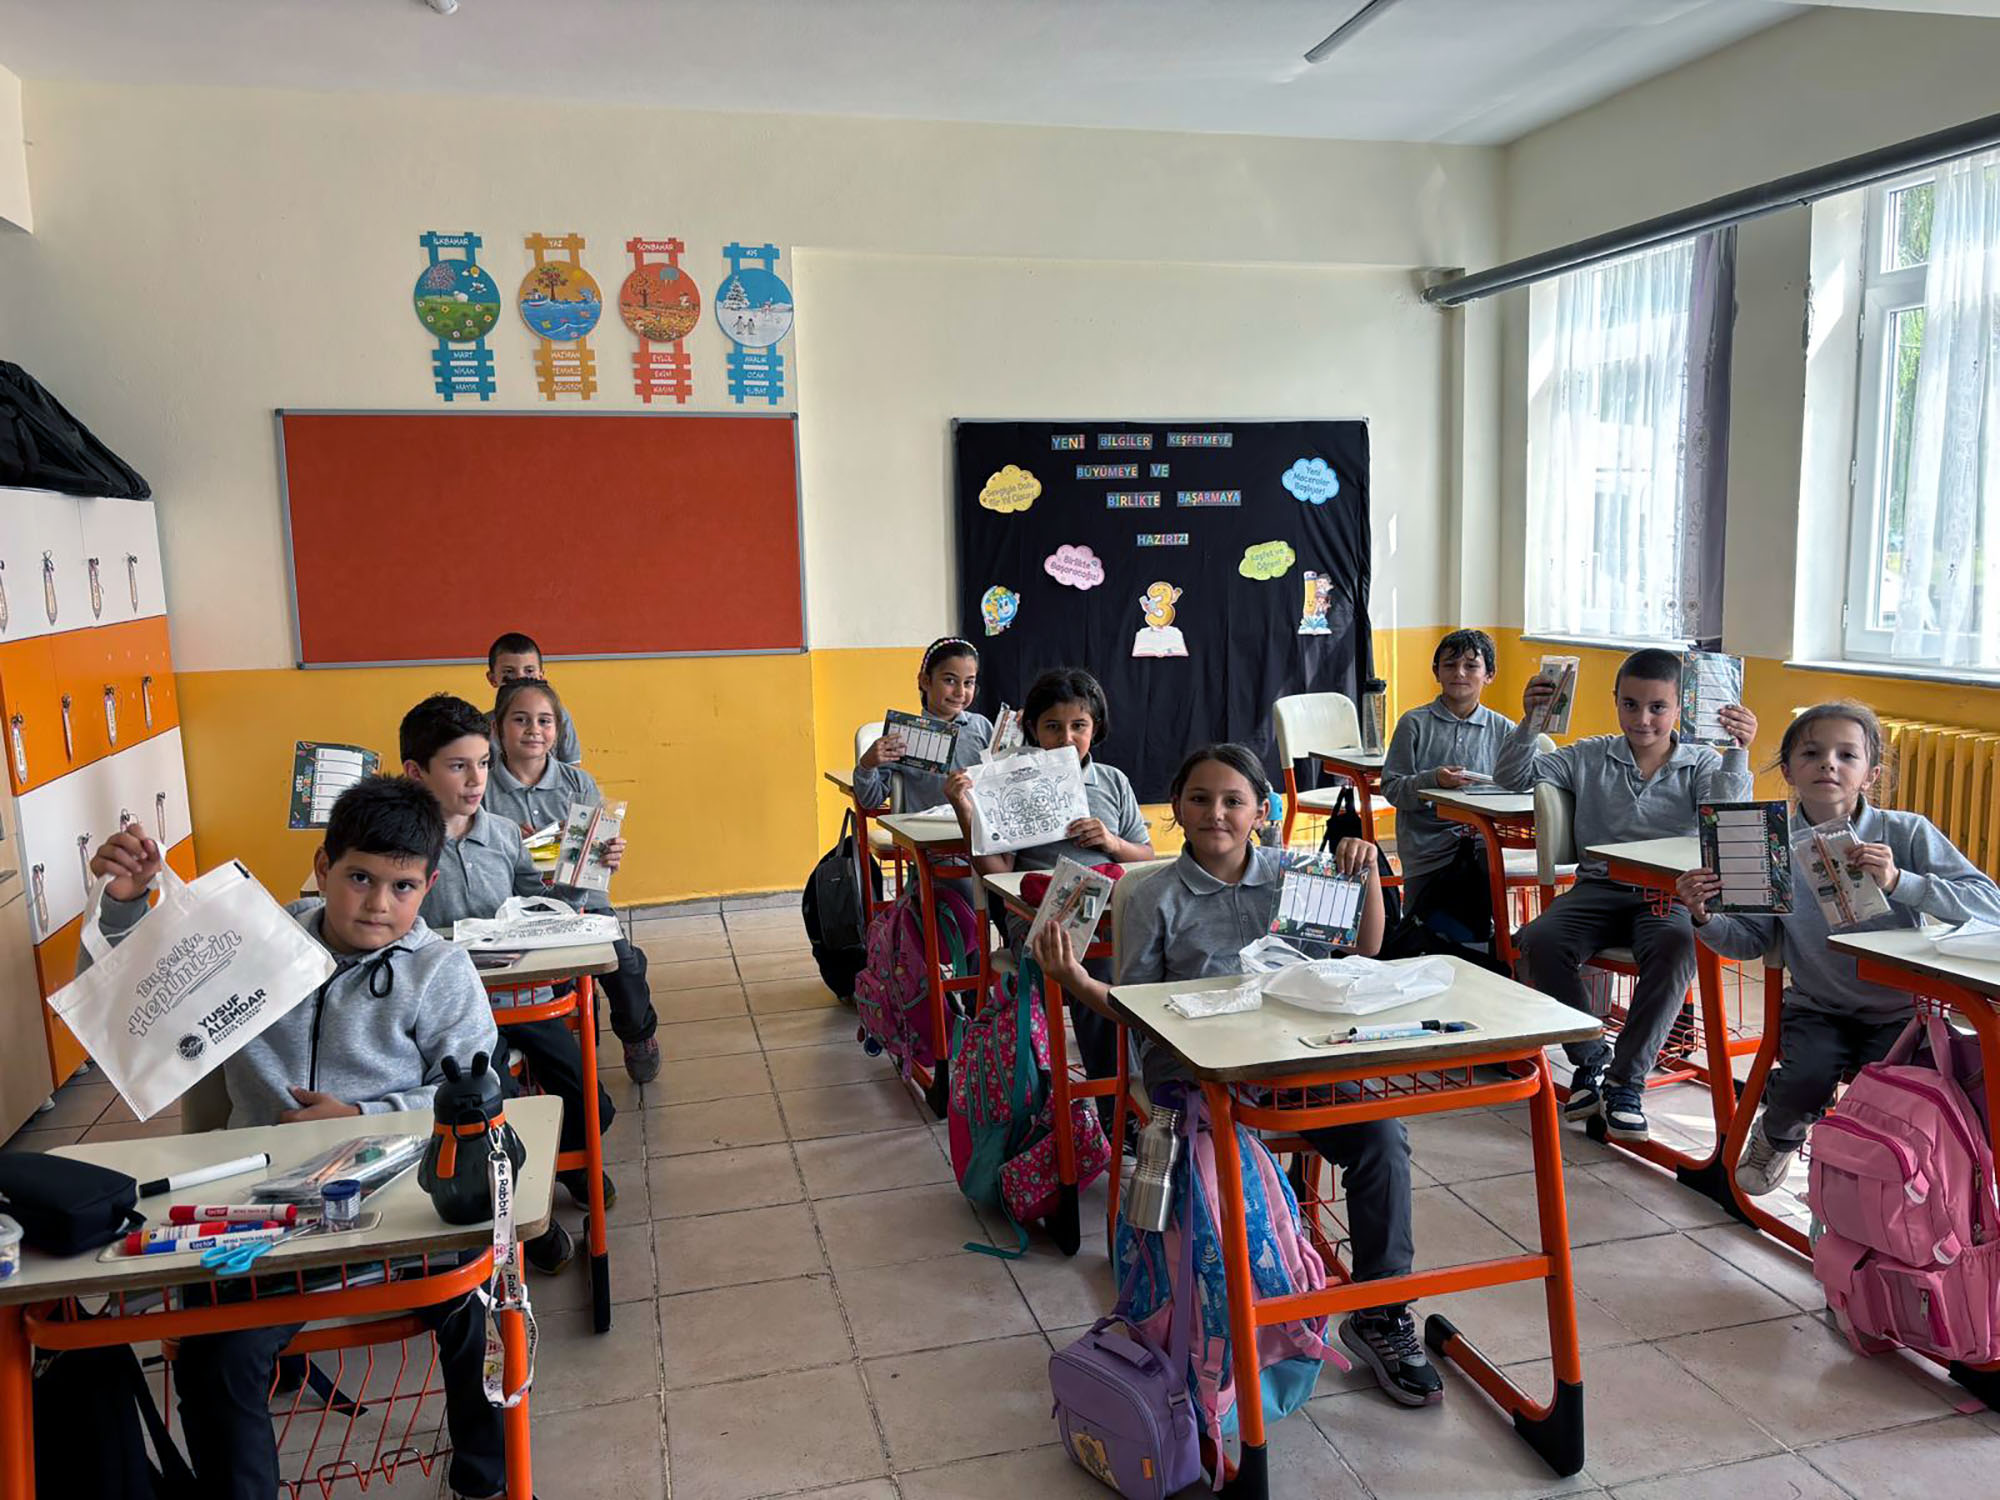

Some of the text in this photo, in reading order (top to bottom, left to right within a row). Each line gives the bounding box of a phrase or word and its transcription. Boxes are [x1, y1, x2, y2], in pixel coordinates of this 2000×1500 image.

[1052, 435, 1085, 449] YENİ
[1100, 434, 1150, 447] BİLGİLER
[1077, 464, 1169, 478] BÜYÜMEYE VE
[1107, 491, 1240, 506] BİRLİKTE BAŞARMAYA
[1137, 534, 1188, 546] HAZIRIZ!
[129, 929, 242, 1038] Hepimizin
[135, 974, 159, 998] Bu
[197, 993, 240, 1029] YUSUF
[207, 988, 267, 1038] ALEMDAR
[498, 1178, 509, 1219] Rabbit
